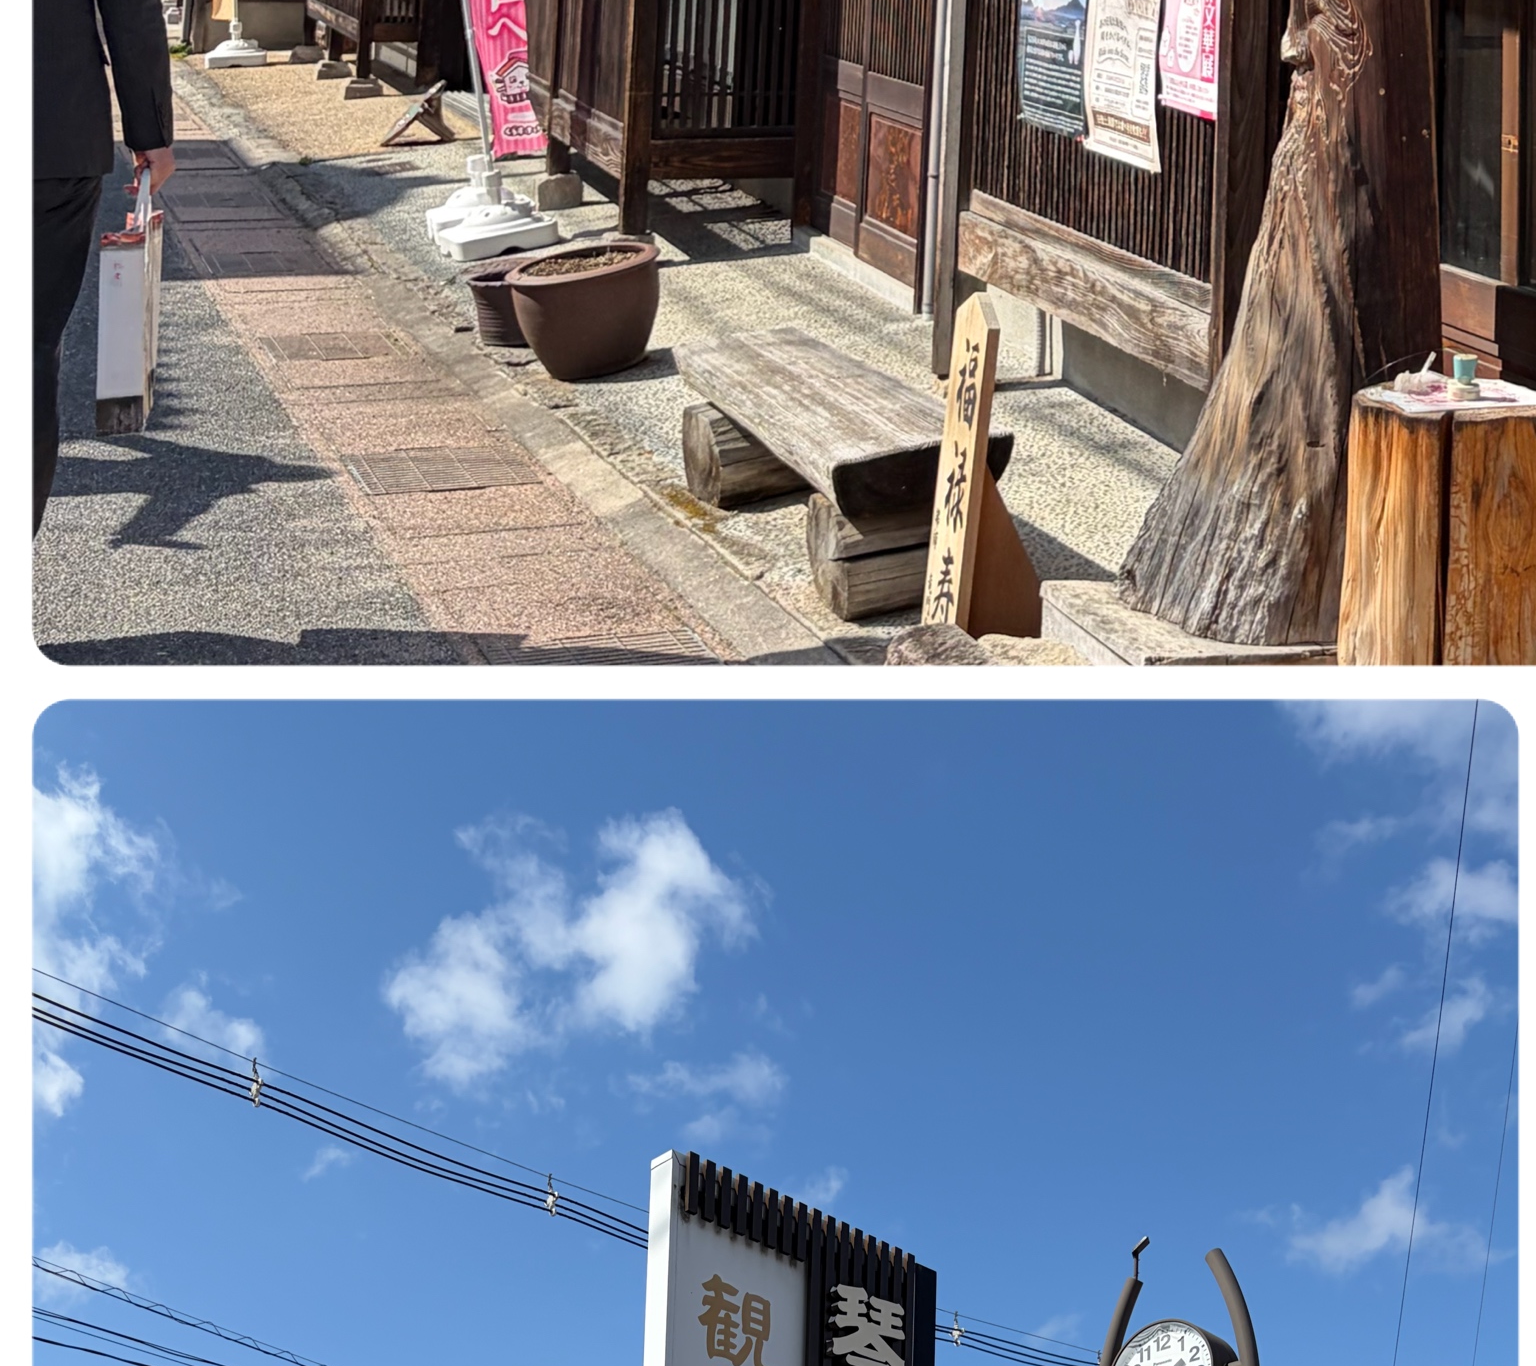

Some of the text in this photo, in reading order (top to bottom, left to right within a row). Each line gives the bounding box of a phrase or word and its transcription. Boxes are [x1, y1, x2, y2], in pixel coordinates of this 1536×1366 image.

[1153, 1335, 1171, 1352] 12
[1178, 1336, 1184, 1351] 1
[1137, 1345, 1150, 1362] 11
[1189, 1346, 1200, 1362] 2
